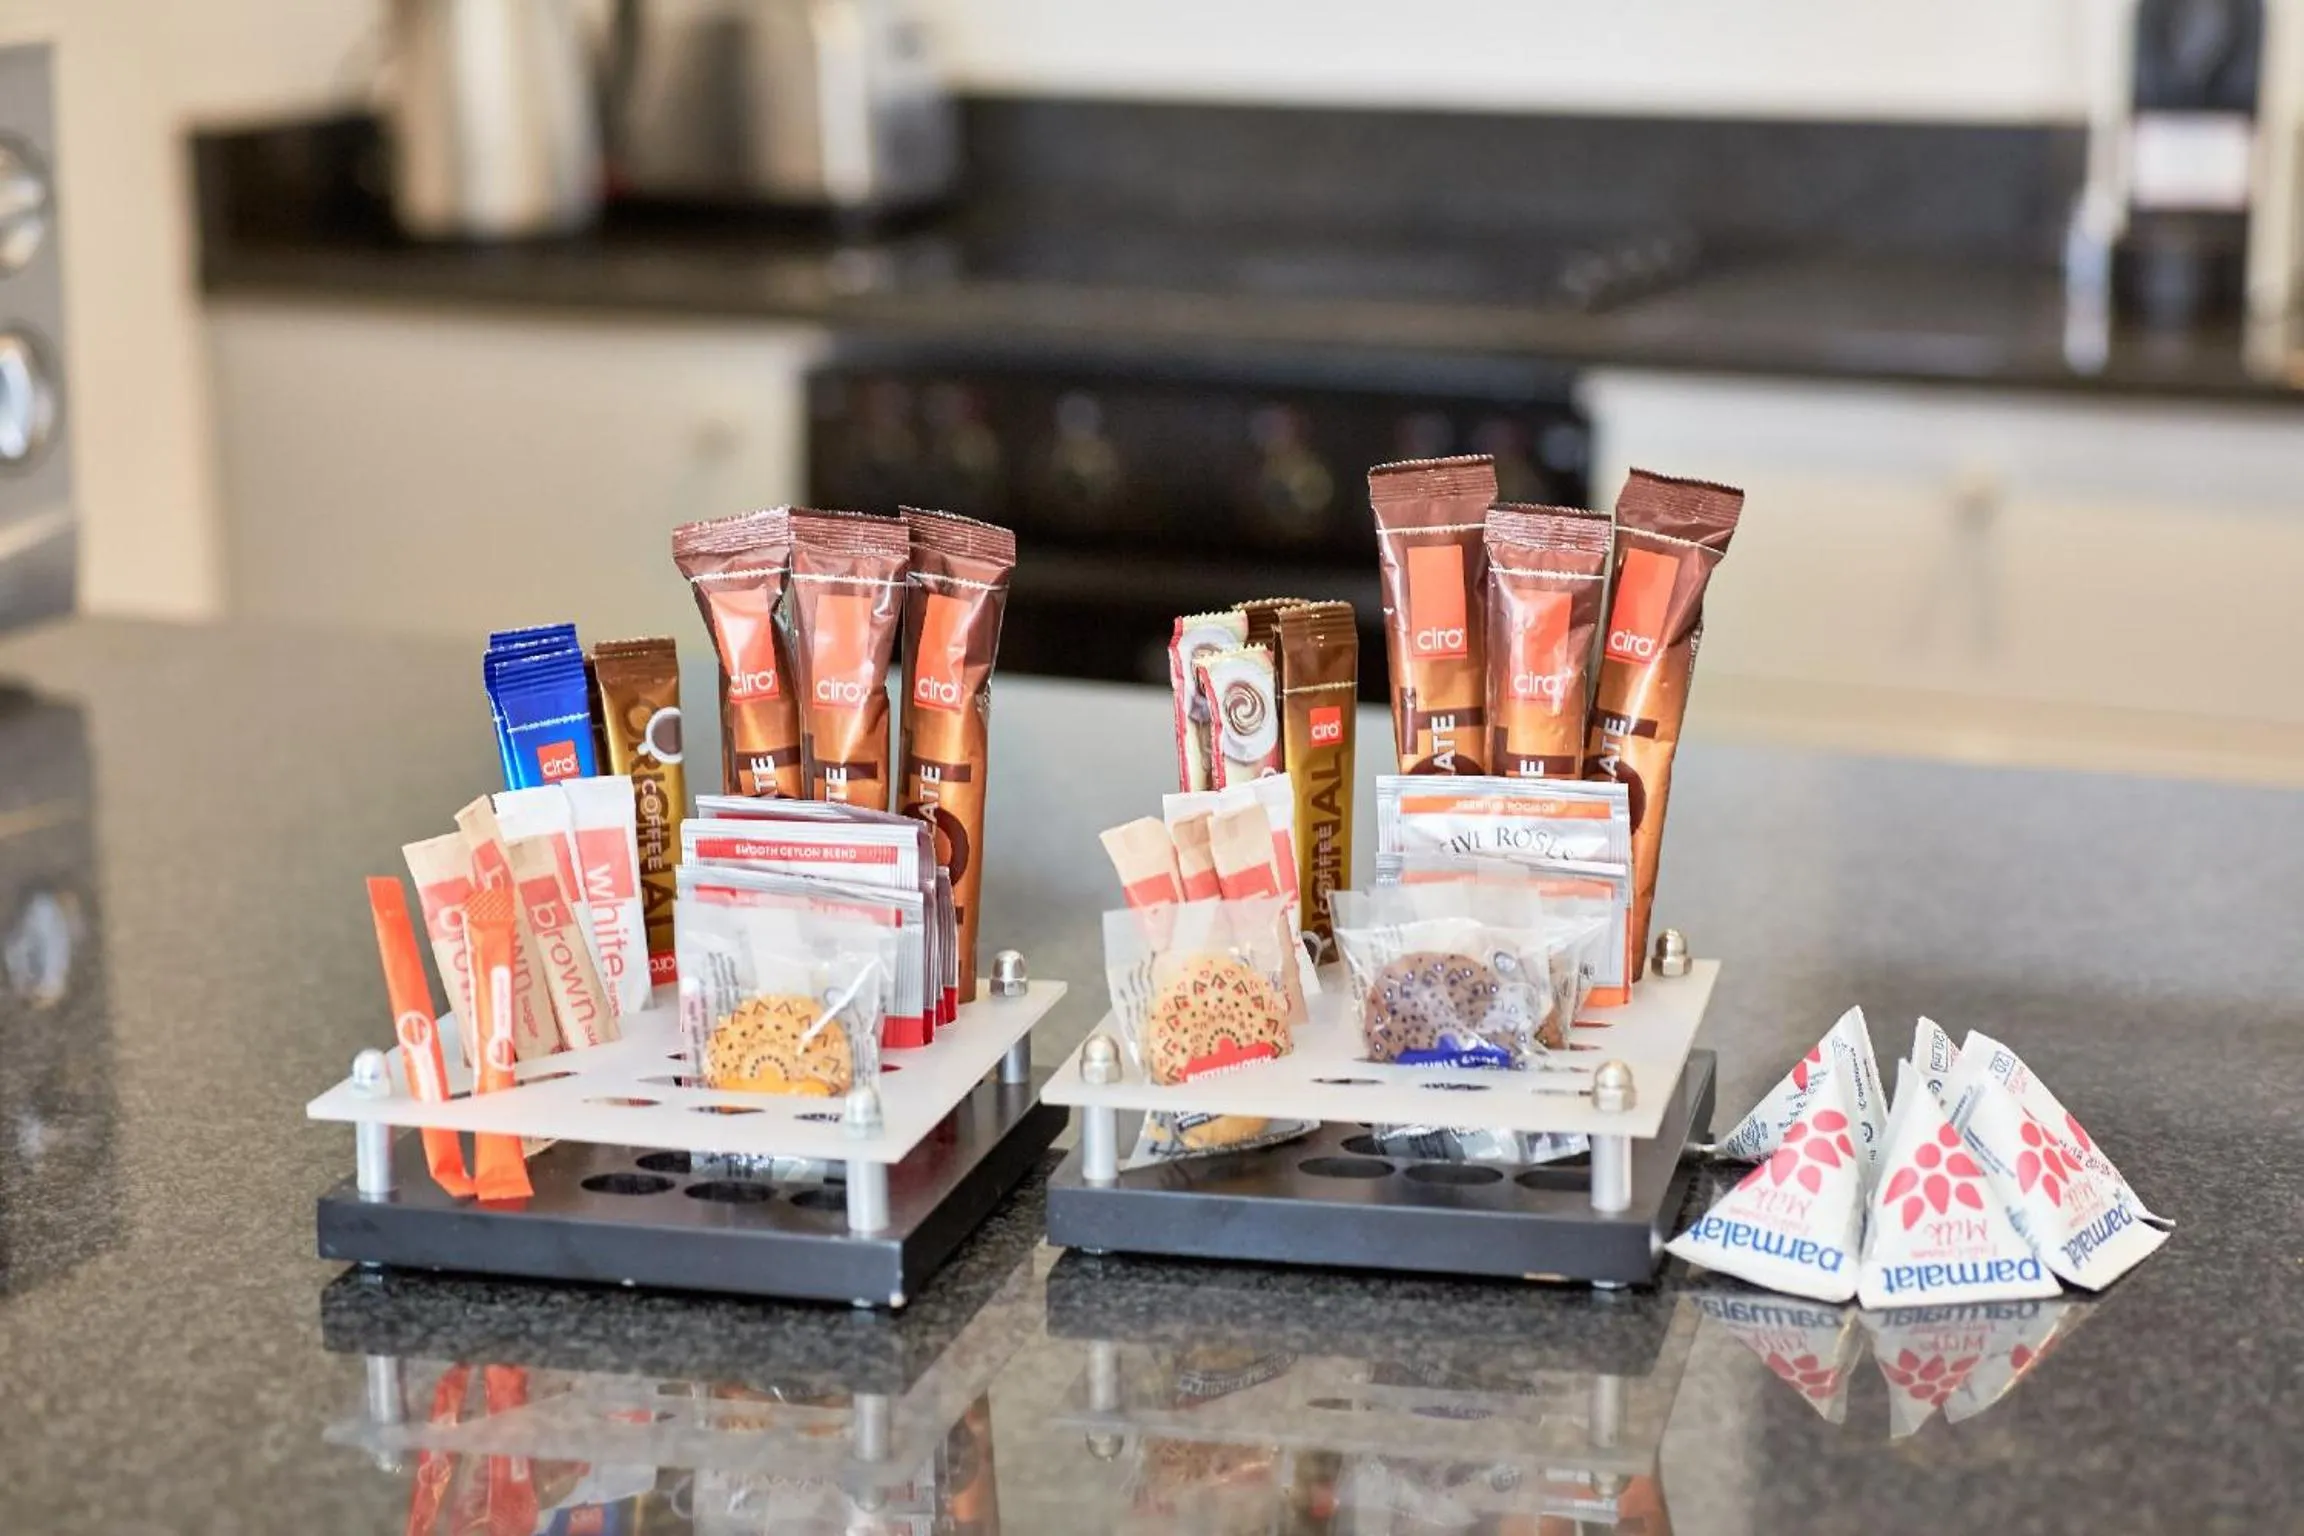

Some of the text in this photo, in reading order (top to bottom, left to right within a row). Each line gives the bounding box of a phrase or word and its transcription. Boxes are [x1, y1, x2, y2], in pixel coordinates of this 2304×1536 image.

[1416, 627, 1463, 651] ciro
[1609, 629, 1655, 657] ciro
[731, 669, 775, 696] ciro
[816, 679, 864, 702] ciro
[917, 678, 958, 703] ciro
[1513, 672, 1566, 698] ciro
[1311, 721, 1342, 740] ciro
[542, 755, 577, 777] ciro
[641, 779, 665, 871] COFFEE
[823, 847, 857, 859] BLEND
[587, 863, 629, 977] white
[531, 901, 598, 1023] brown
[1690, 1215, 1845, 1274] parmalat
[1923, 1218, 1989, 1246] Milk
[2060, 1203, 2133, 1270] parmalat
[1881, 1257, 2041, 1295] parmalat
